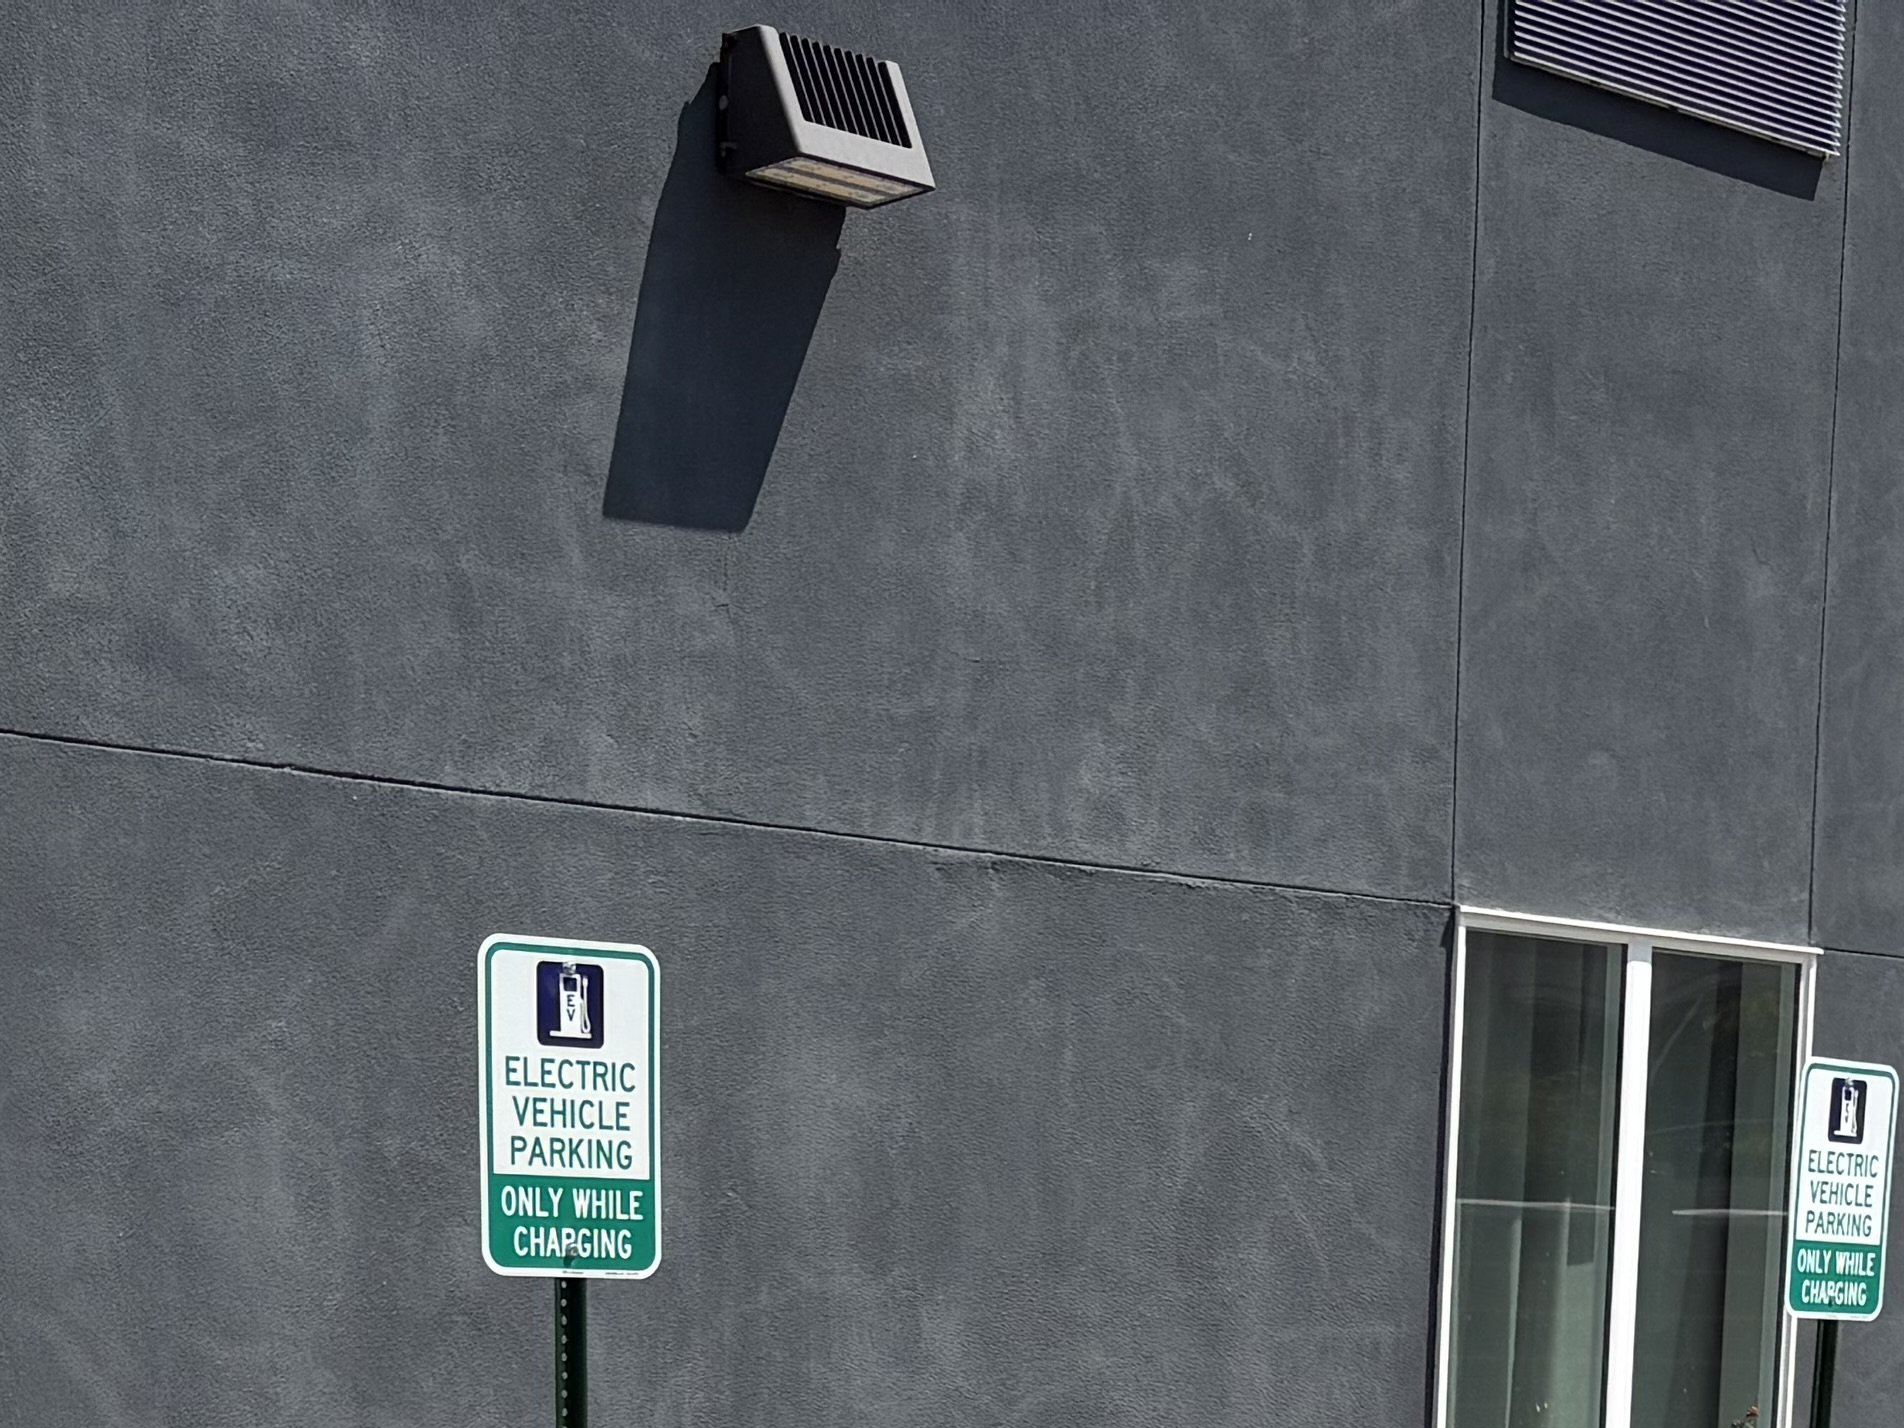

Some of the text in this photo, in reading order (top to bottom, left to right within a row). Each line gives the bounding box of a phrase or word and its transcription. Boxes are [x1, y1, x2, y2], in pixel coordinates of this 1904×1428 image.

[505, 1055, 636, 1093] ELECTRIC
[512, 1095, 631, 1131] VEHICLE
[510, 1135, 633, 1170] PARKING
[1807, 1149, 1880, 1178] ELECTRIC
[501, 1185, 644, 1220] ONLY WHILE
[1810, 1180, 1874, 1208] VEHICLE
[1805, 1209, 1872, 1237] PARKING
[513, 1225, 632, 1260] CHARGING
[1797, 1248, 1876, 1277] ONLY WHILE
[1801, 1279, 1867, 1306] CHARGING
